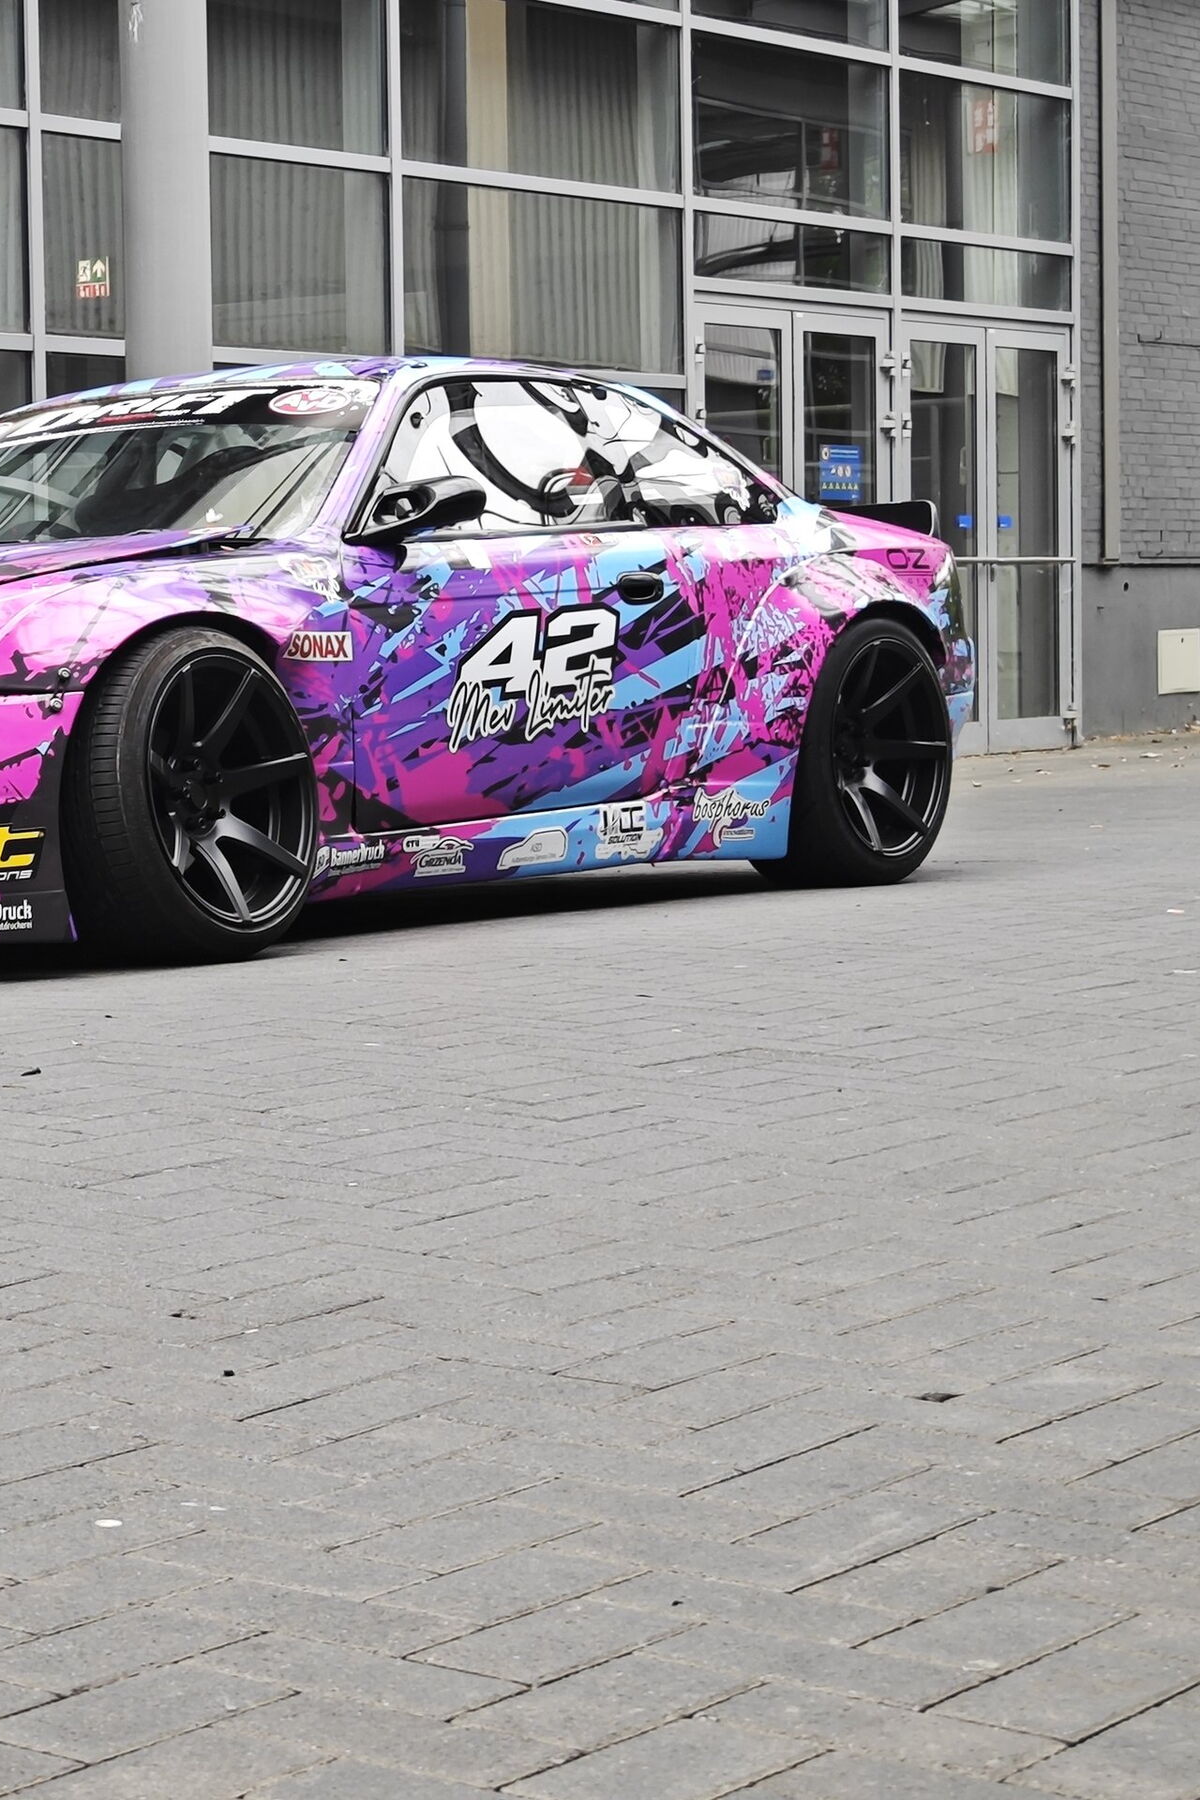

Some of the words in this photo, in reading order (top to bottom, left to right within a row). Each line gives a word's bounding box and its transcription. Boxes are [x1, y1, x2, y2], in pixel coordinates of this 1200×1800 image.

[287, 634, 348, 658] SONAX
[459, 606, 618, 695] 42
[527, 655, 614, 738] Limiter
[694, 790, 769, 831] bosphorus
[330, 838, 386, 868] BannerDruck
